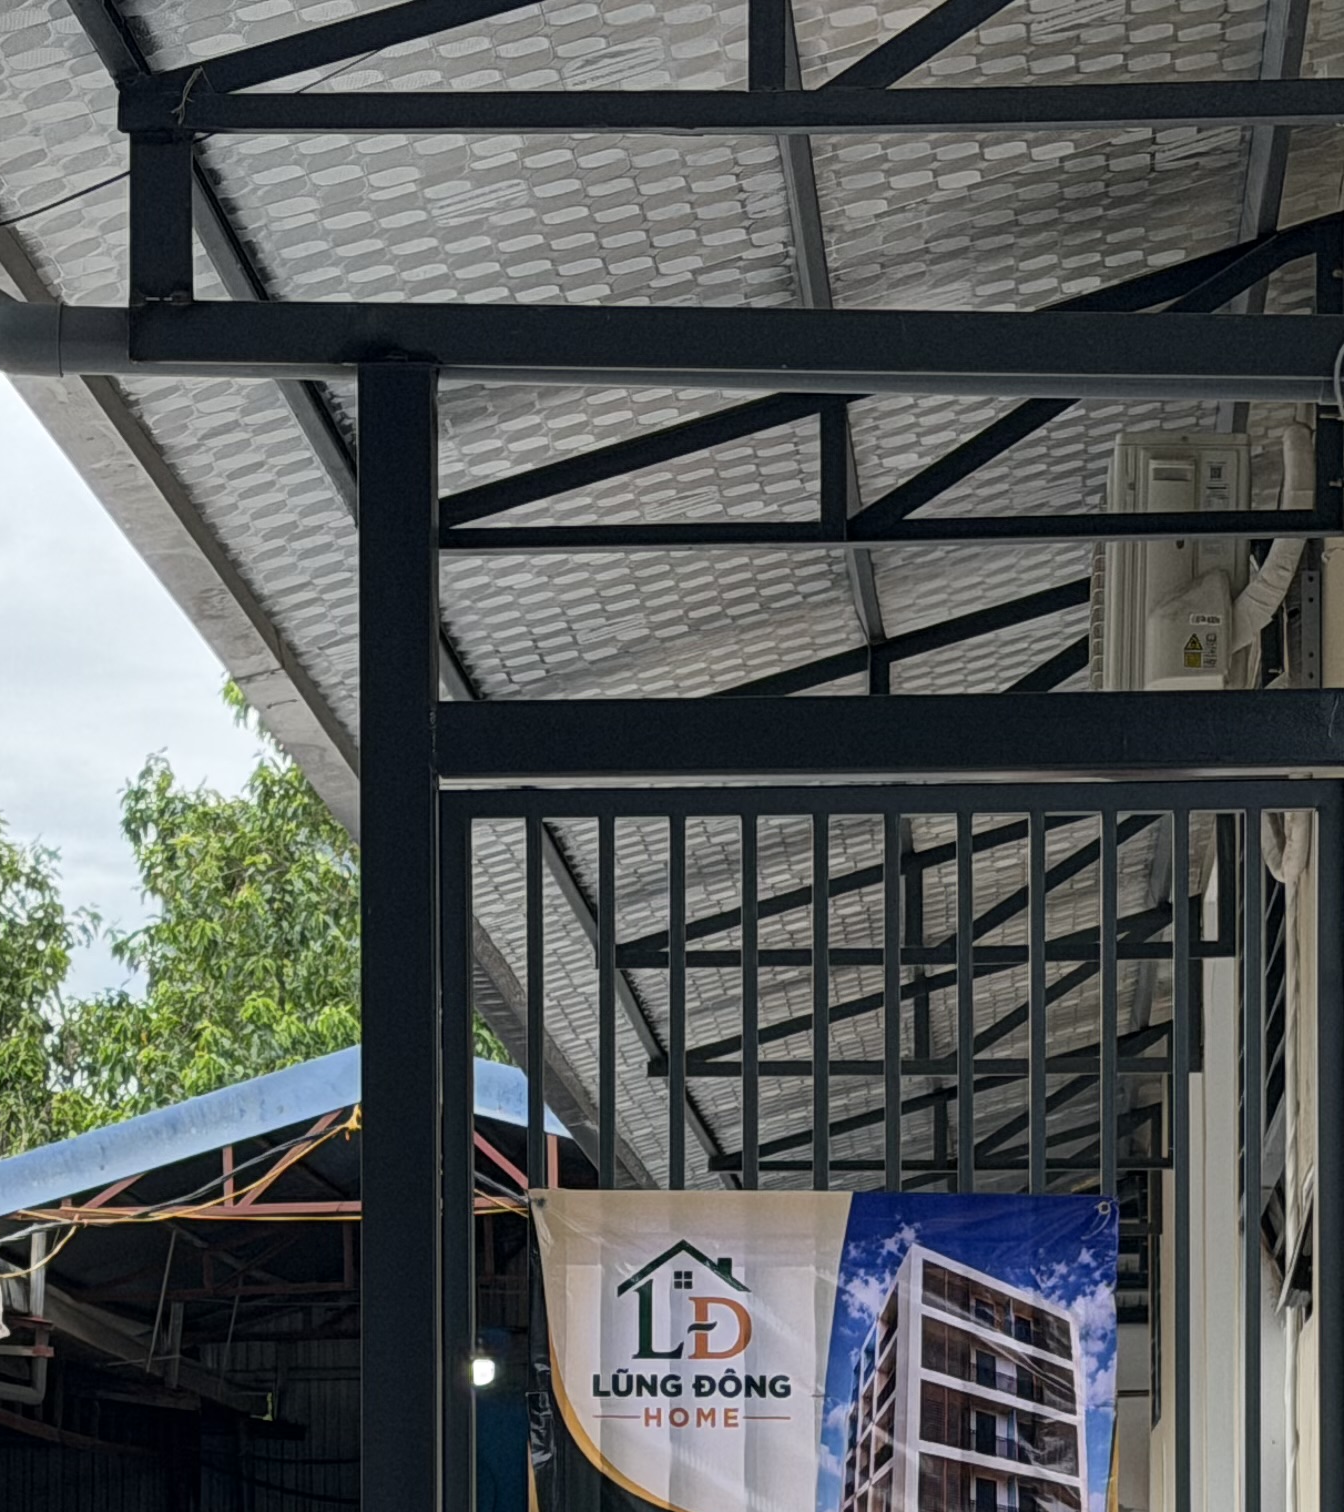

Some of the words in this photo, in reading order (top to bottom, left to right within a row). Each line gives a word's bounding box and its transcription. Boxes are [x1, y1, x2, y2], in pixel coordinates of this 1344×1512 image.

[592, 1368, 683, 1398] LŨNG
[692, 1368, 792, 1398] ĐÔNG
[644, 1407, 740, 1428] HOME
